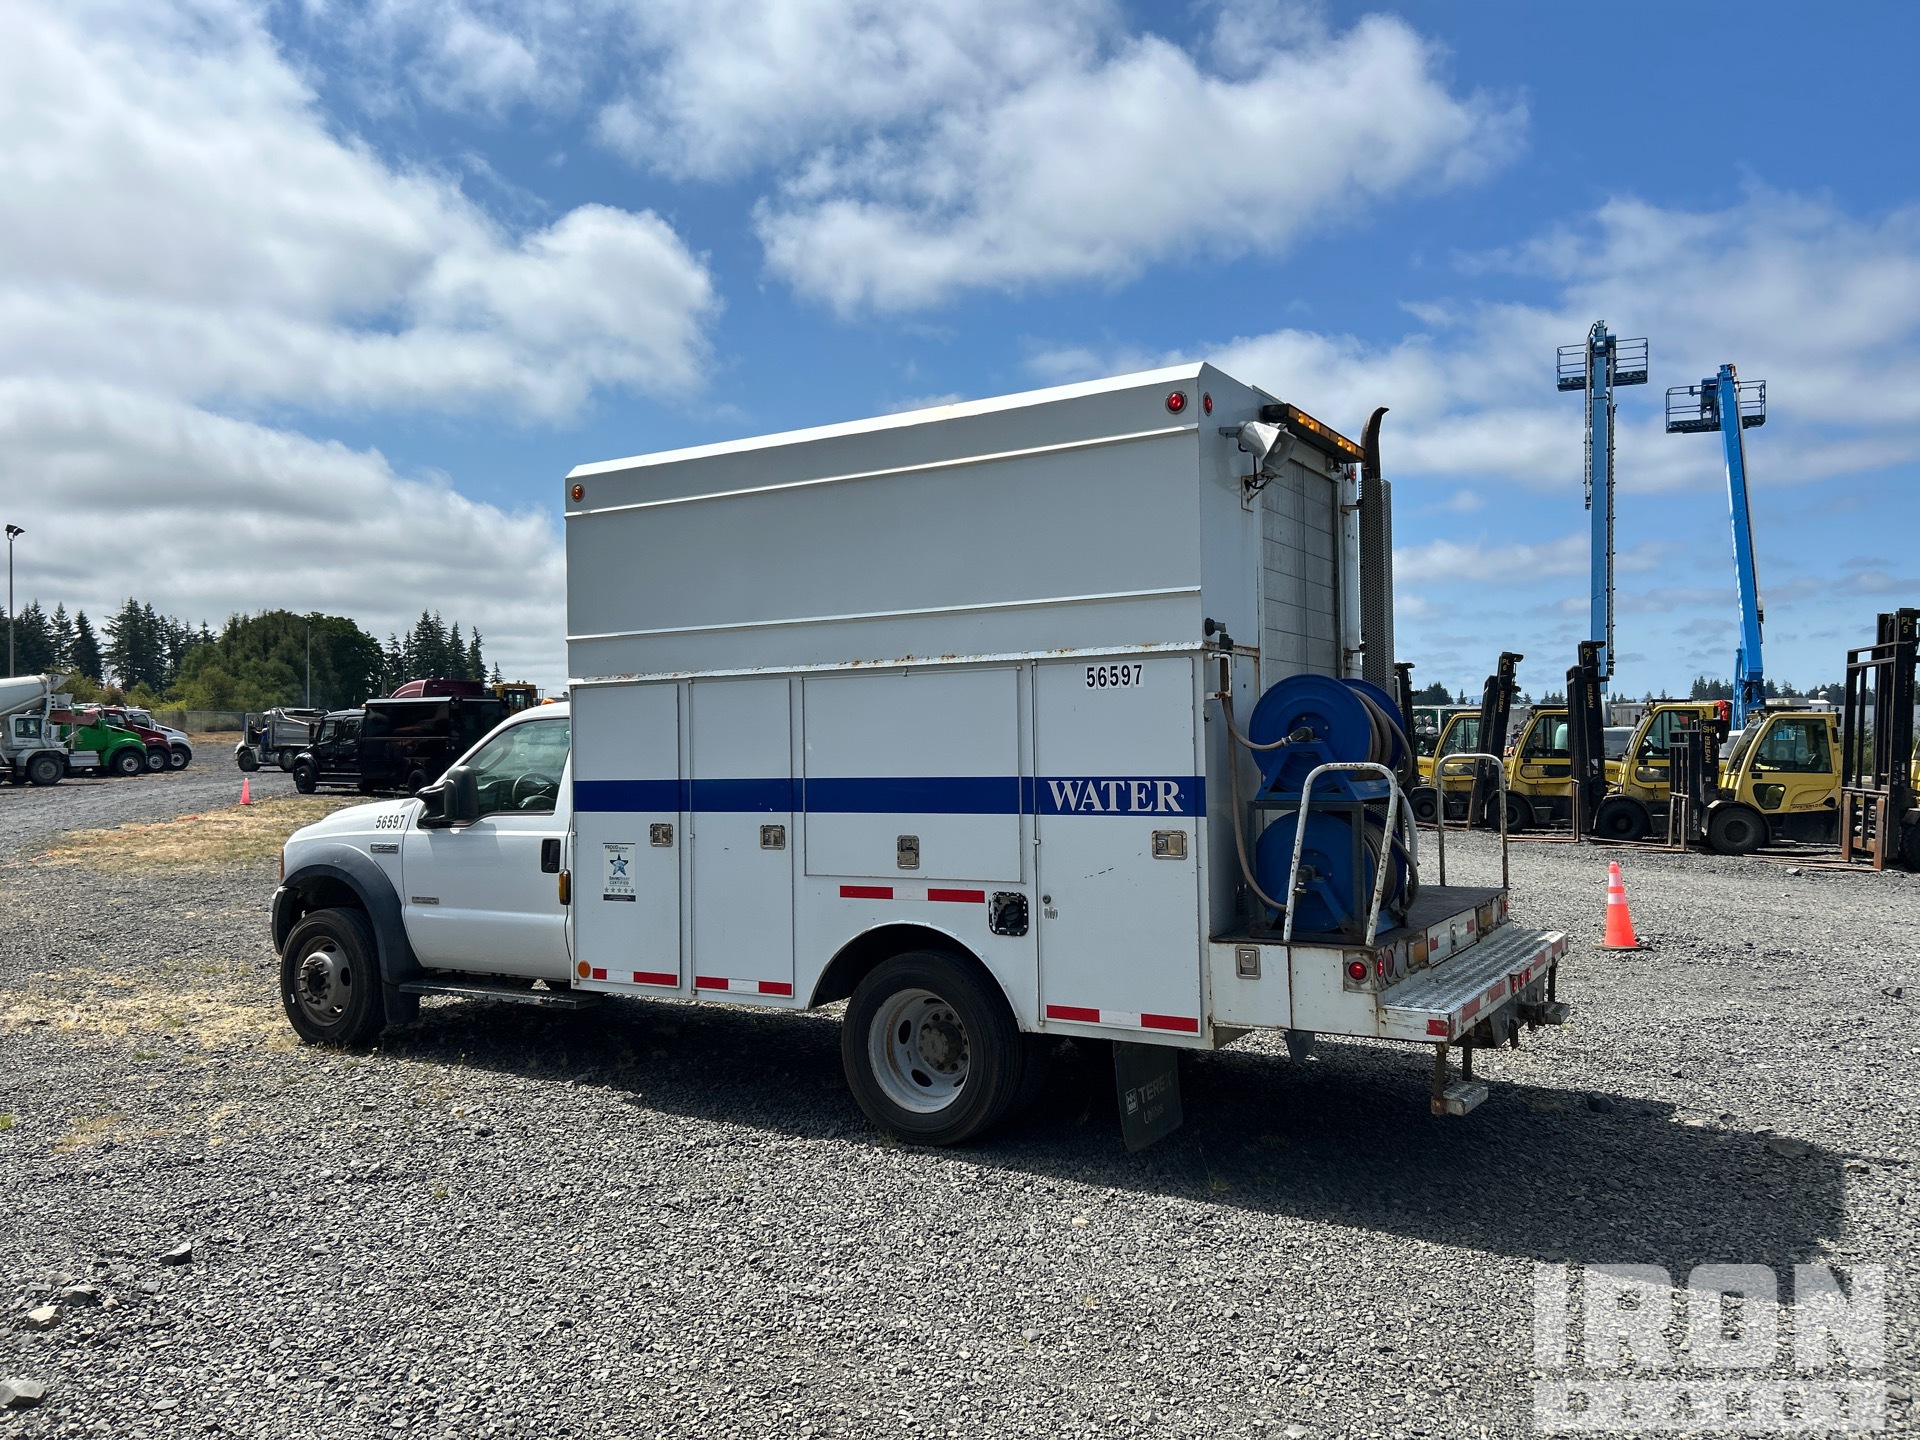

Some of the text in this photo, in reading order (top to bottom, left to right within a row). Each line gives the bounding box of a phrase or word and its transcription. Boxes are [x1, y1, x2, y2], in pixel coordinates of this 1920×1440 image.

[1901, 617, 1913, 625] PL
[1903, 625, 1909, 633] 5
[1086, 664, 1142, 688] 56597
[1702, 725, 1716, 733] SH1
[1047, 780, 1183, 812] WATER
[375, 815, 405, 829] 56597
